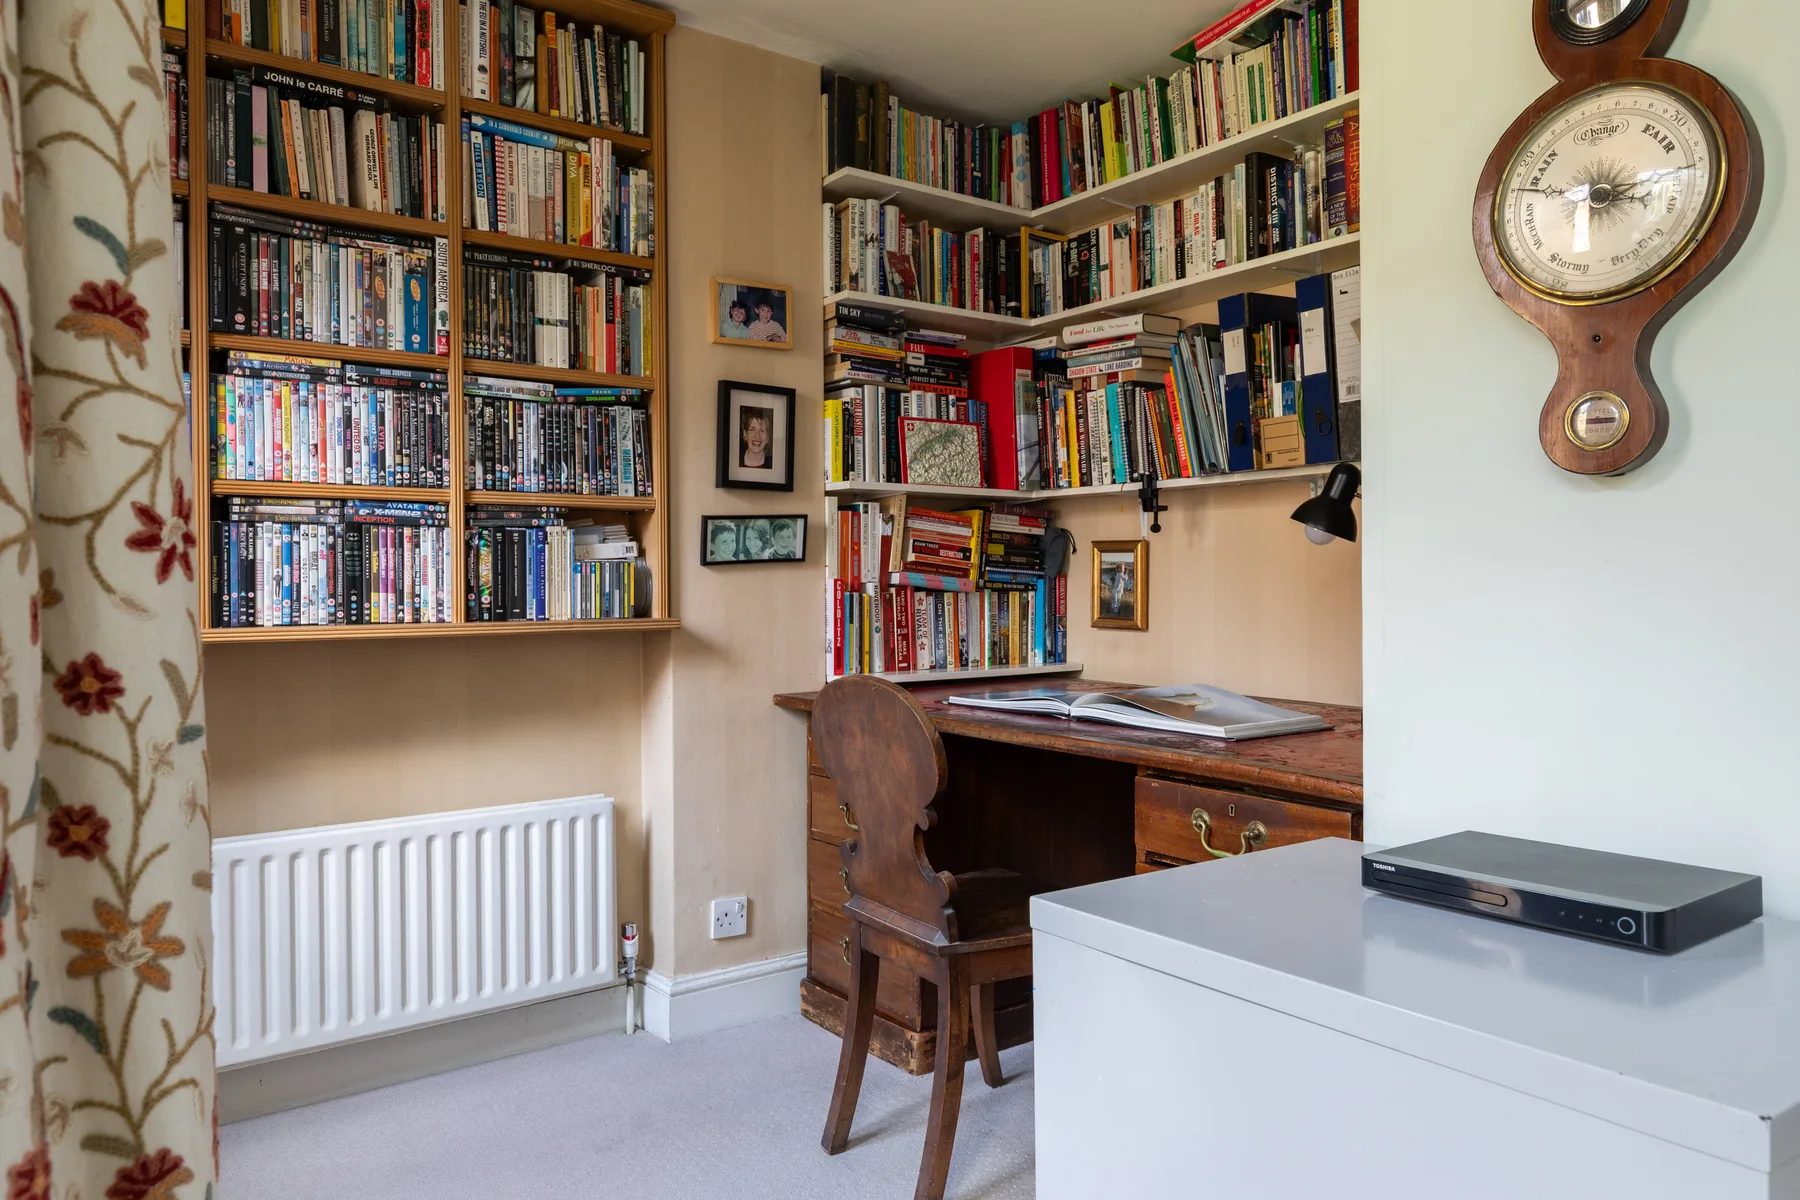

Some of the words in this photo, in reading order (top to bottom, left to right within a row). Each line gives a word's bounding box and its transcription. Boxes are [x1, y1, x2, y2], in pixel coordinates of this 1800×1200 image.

[479, 1, 487, 10] THE
[479, 11, 487, 19] EU
[479, 32, 487, 59] NUTSHELL
[263, 71, 294, 87] JOHN
[295, 79, 306, 89] le
[307, 79, 344, 98] CARRÉ
[1668, 109, 1688, 127] 30
[1641, 122, 1677, 155] FAIR
[474, 143, 482, 160] BILL
[1349, 121, 1360, 181] ATHENS
[1519, 150, 1535, 169] 29
[569, 155, 577, 178] DIVA
[1529, 149, 1559, 188] RAIN
[476, 162, 485, 197] BRYSON
[532, 169, 540, 194] Bryson
[1269, 167, 1277, 206] DISTRICT
[1330, 216, 1346, 224] WORLD
[437, 242, 448, 267] SOUTH
[1070, 241, 1078, 263] D-DAY
[1610, 248, 1641, 266] Very
[581, 260, 616, 274] SHERLOCK
[1547, 252, 1590, 275] Stormy
[1333, 272, 1344, 280] Box
[438, 269, 449, 303] AMERICA
[295, 297, 303, 312] MEN
[838, 305, 849, 315] TIN
[849, 308, 862, 318] SKY
[1069, 328, 1084, 337] Food
[1092, 324, 1105, 333] Life
[910, 343, 925, 353] FALL
[284, 355, 313, 366] MATILDA
[1069, 367, 1085, 377] SHADOW
[1085, 365, 1097, 374] STATE
[1104, 363, 1115, 372] LUKE
[1114, 360, 1133, 370] HARDING
[1047, 373, 1067, 383] TOTAL
[854, 397, 863, 436] COLLUSION
[353, 444, 360, 454] 93
[1079, 434, 1087, 473] WOODWARD
[1177, 433, 1186, 461] COOKBOOK
[386, 502, 419, 510] AVATAR
[353, 515, 395, 523] INCEPTION
[939, 549, 963, 559] DESTRUCTION
[937, 603, 942, 615] ON
[915, 608, 923, 640] RIVALS
[1372, 862, 1396, 872] TOSHIBA
